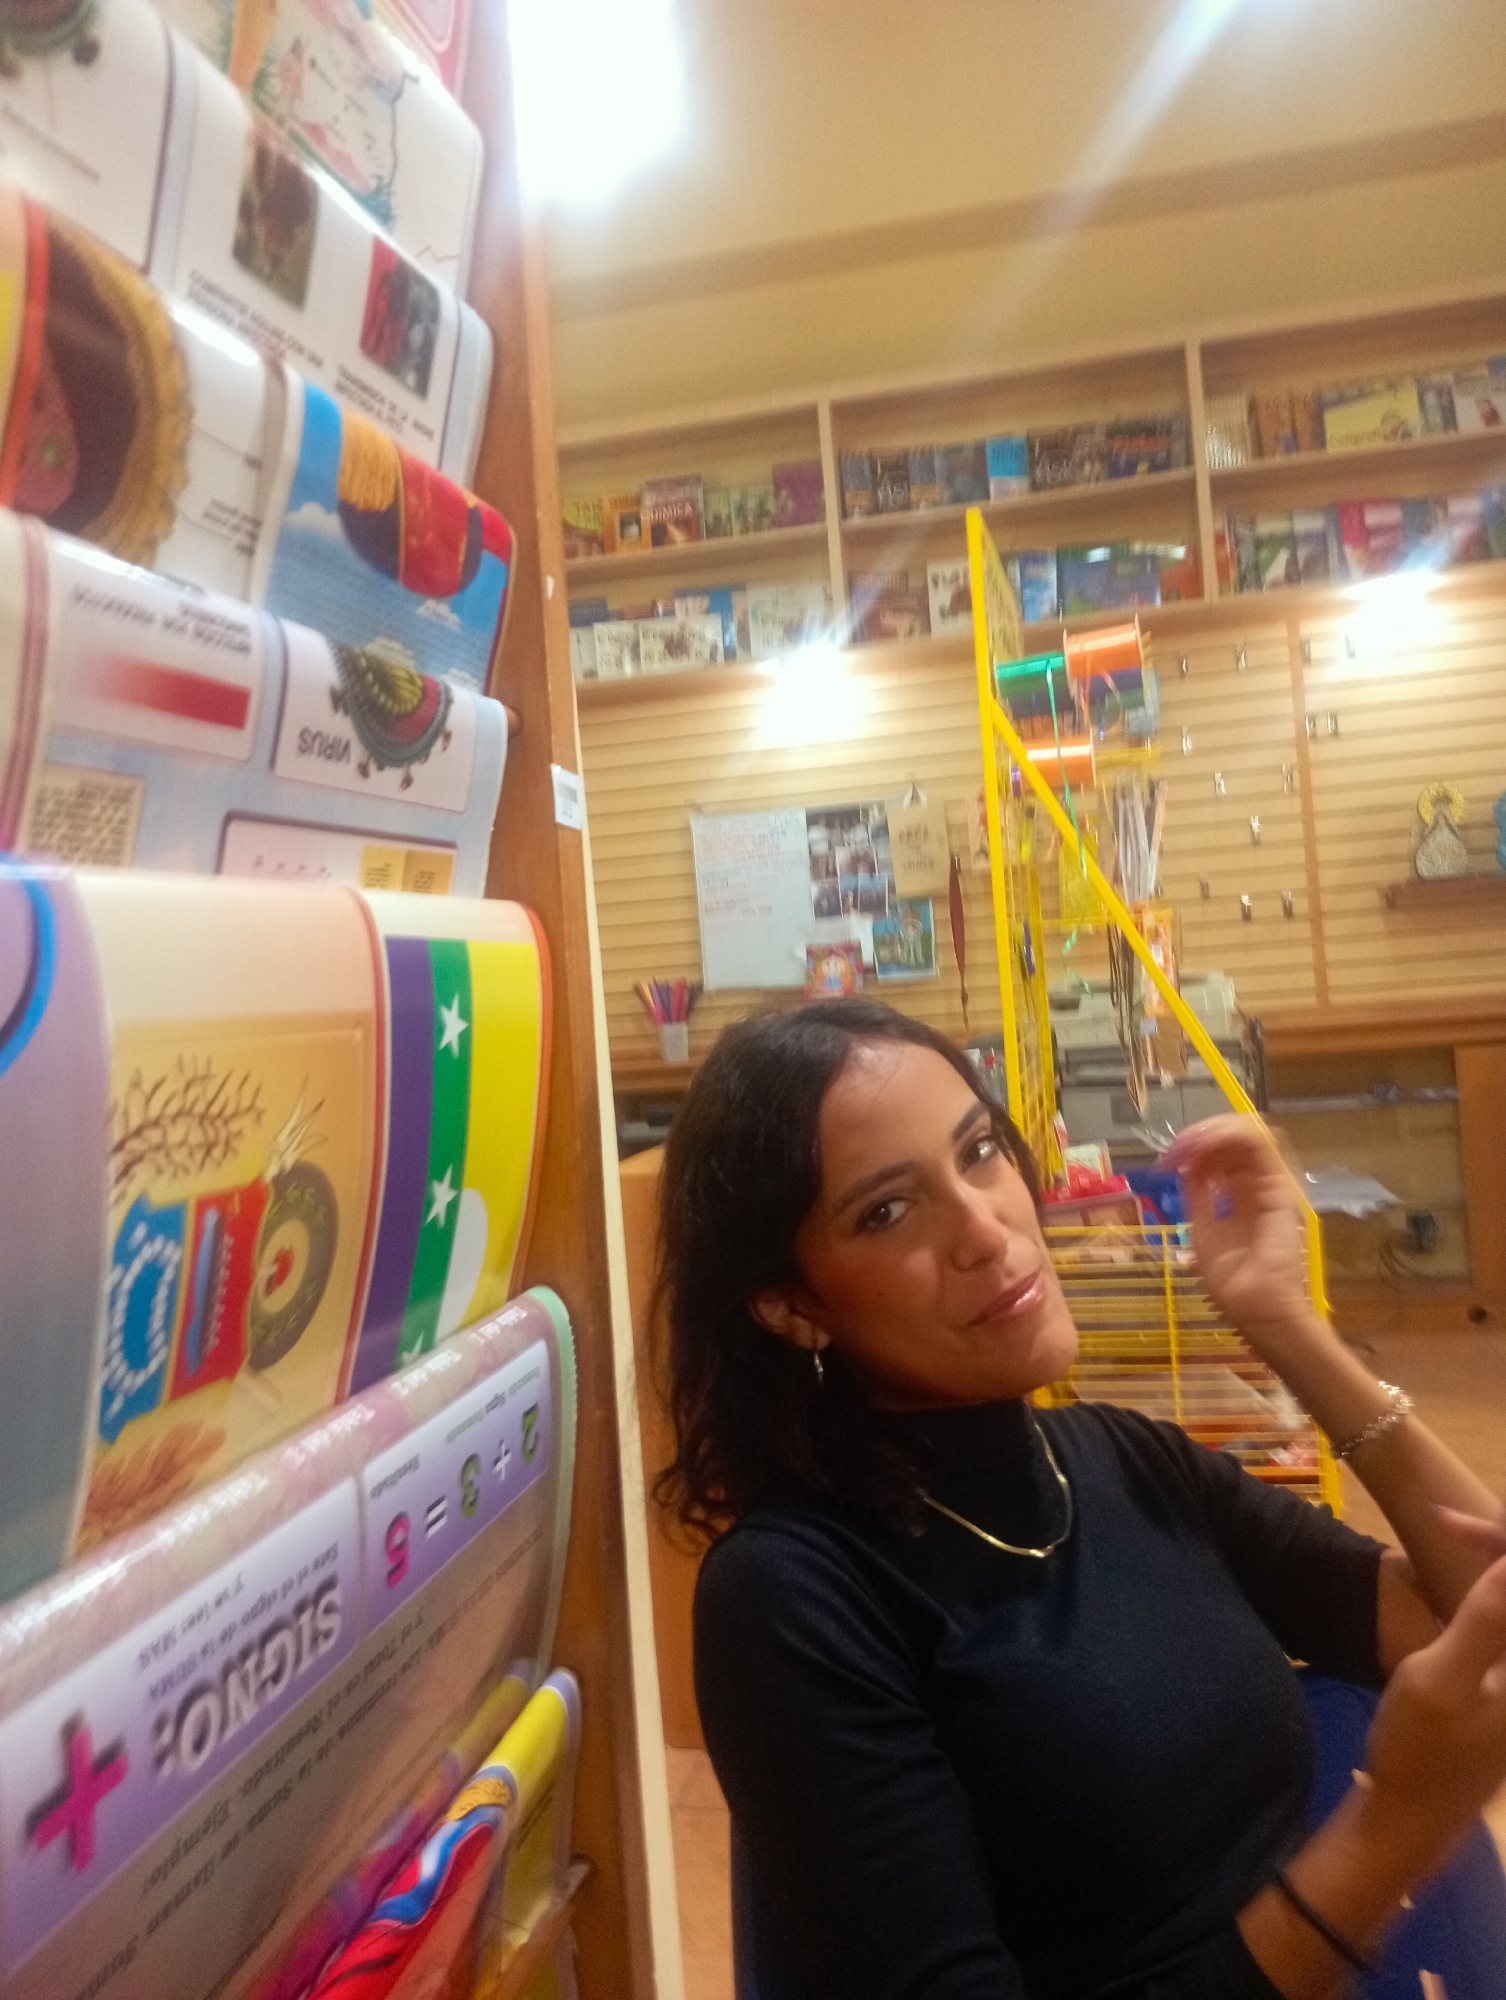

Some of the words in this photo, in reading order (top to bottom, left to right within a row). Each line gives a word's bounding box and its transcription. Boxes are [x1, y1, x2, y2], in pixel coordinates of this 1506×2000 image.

[298, 726, 351, 763] VIRUS
[522, 1405, 539, 1465] 2
[461, 1455, 482, 1519] 3
[386, 1512, 411, 1589] 5
[241, 1590, 279, 1627] signo
[201, 1636, 216, 1658] la
[219, 1620, 237, 1645] de
[149, 1657, 198, 1701] SUMA
[153, 1575, 341, 1778] SIGNO:
[364, 1638, 397, 1681] Total
[317, 1735, 333, 1763] de
[247, 1778, 293, 1832] Suma
